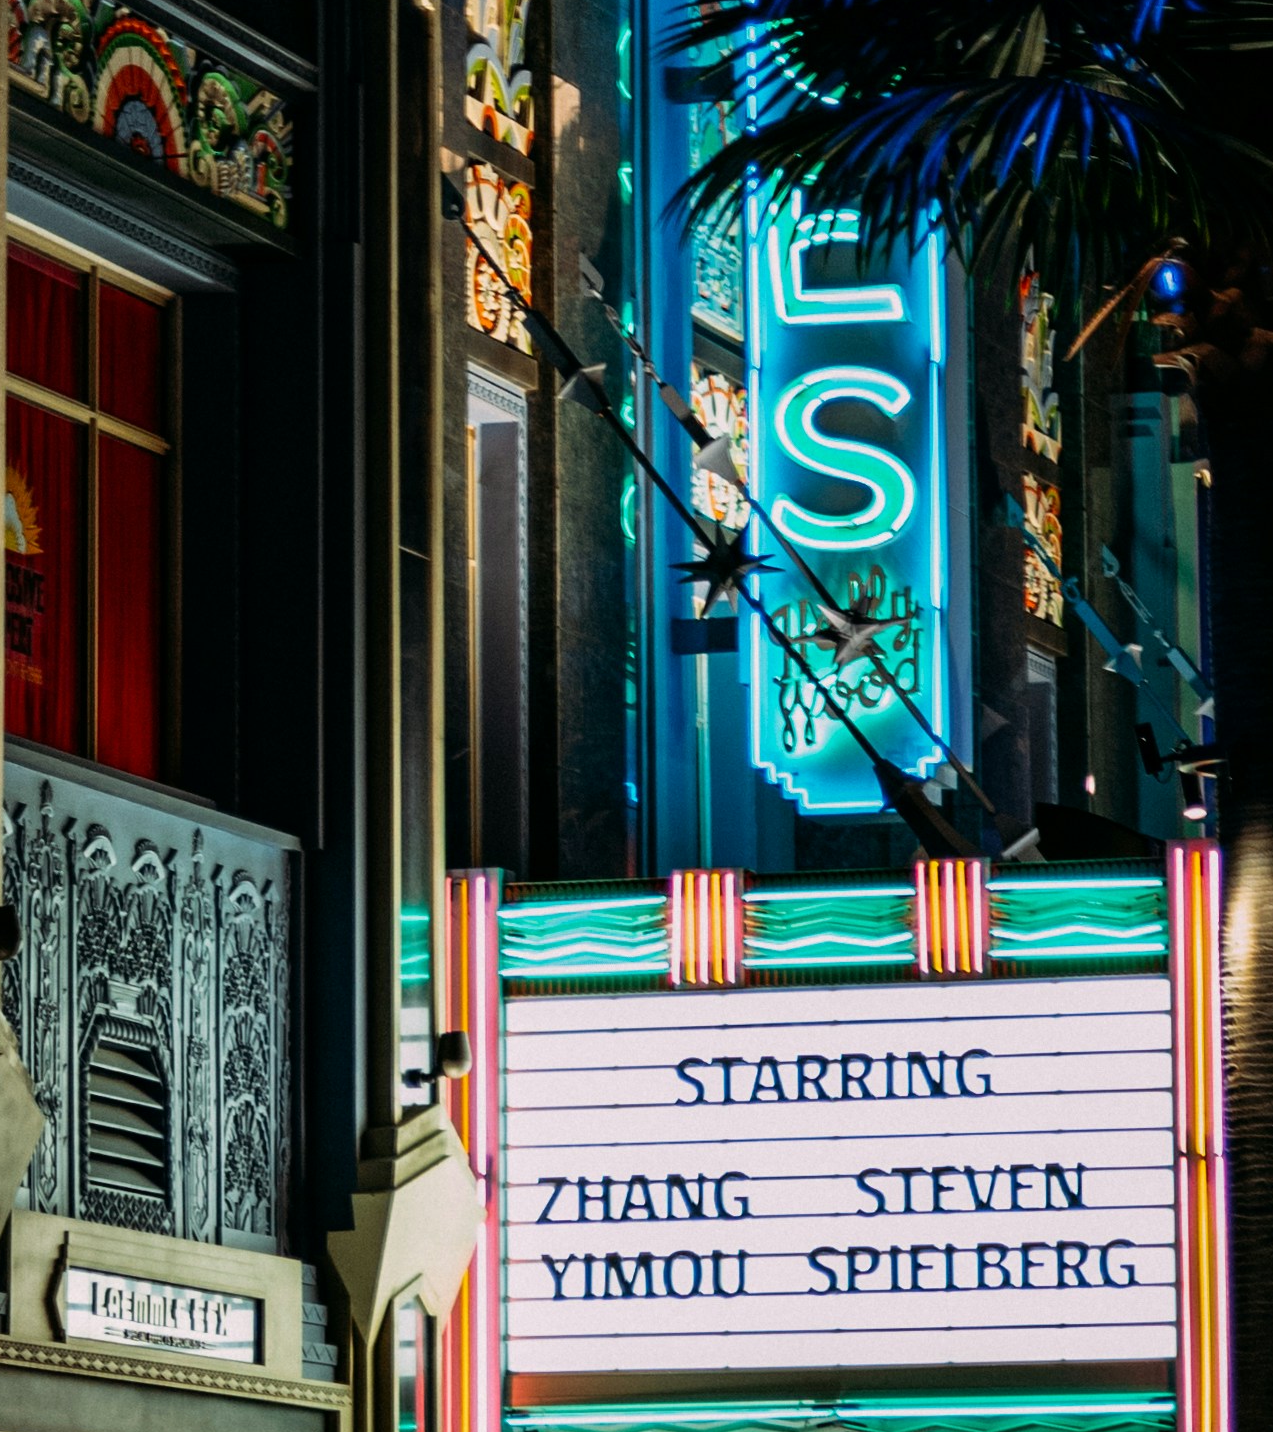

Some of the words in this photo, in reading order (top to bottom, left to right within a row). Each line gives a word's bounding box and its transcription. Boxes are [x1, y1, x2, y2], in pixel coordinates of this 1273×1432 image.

[674, 1049, 995, 1106] STARRING
[535, 1171, 752, 1225] ZHANG
[855, 1162, 1087, 1217] STEVEN
[540, 1249, 749, 1300] YIMOU
[806, 1239, 1139, 1295] SPIELBERG
[92, 1282, 187, 1330] LAEMMLE
[189, 1296, 231, 1336] EFX
